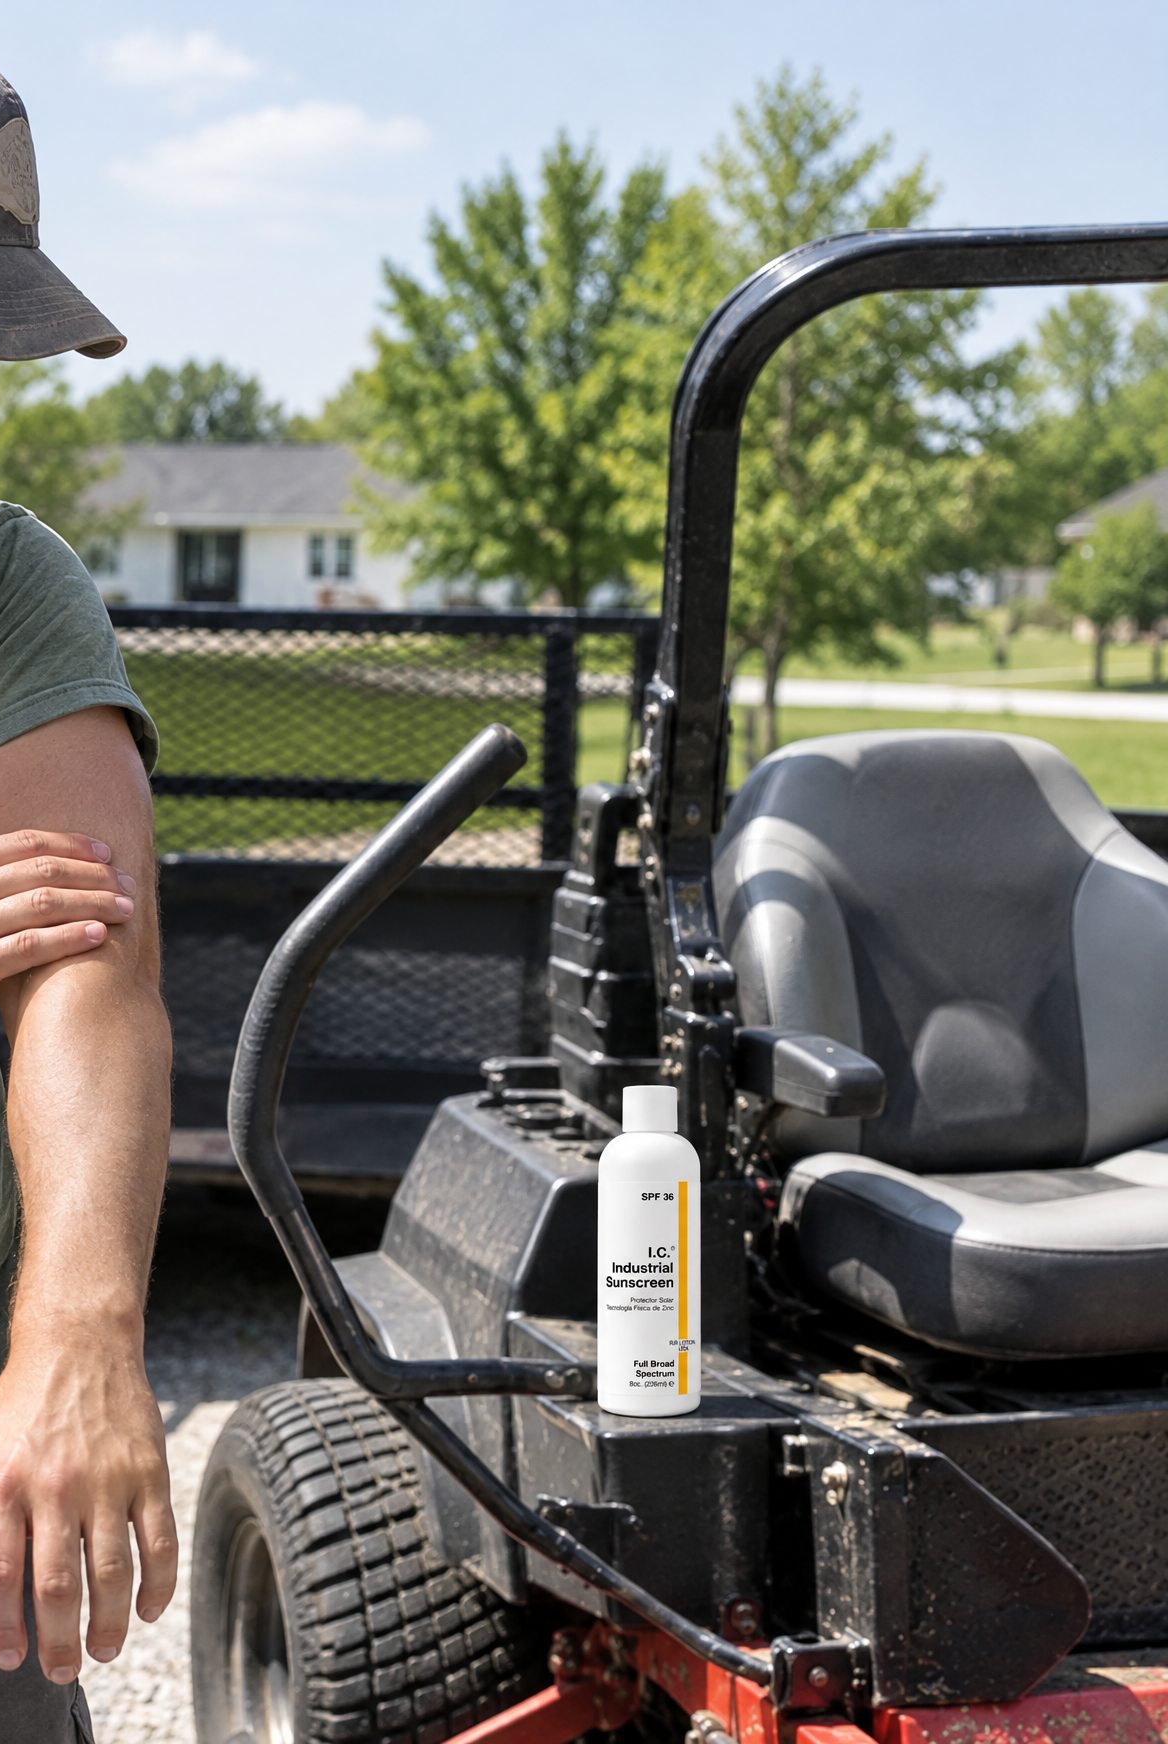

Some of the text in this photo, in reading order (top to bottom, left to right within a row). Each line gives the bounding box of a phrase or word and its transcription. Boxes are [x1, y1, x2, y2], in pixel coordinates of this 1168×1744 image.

[641, 1192, 674, 1201] SPF 36
[612, 1262, 674, 1274] Industrial
[606, 1275, 674, 1288] Sunscreen
[633, 1360, 675, 1368] Full Broad
[635, 1370, 675, 1379] Spectrum
